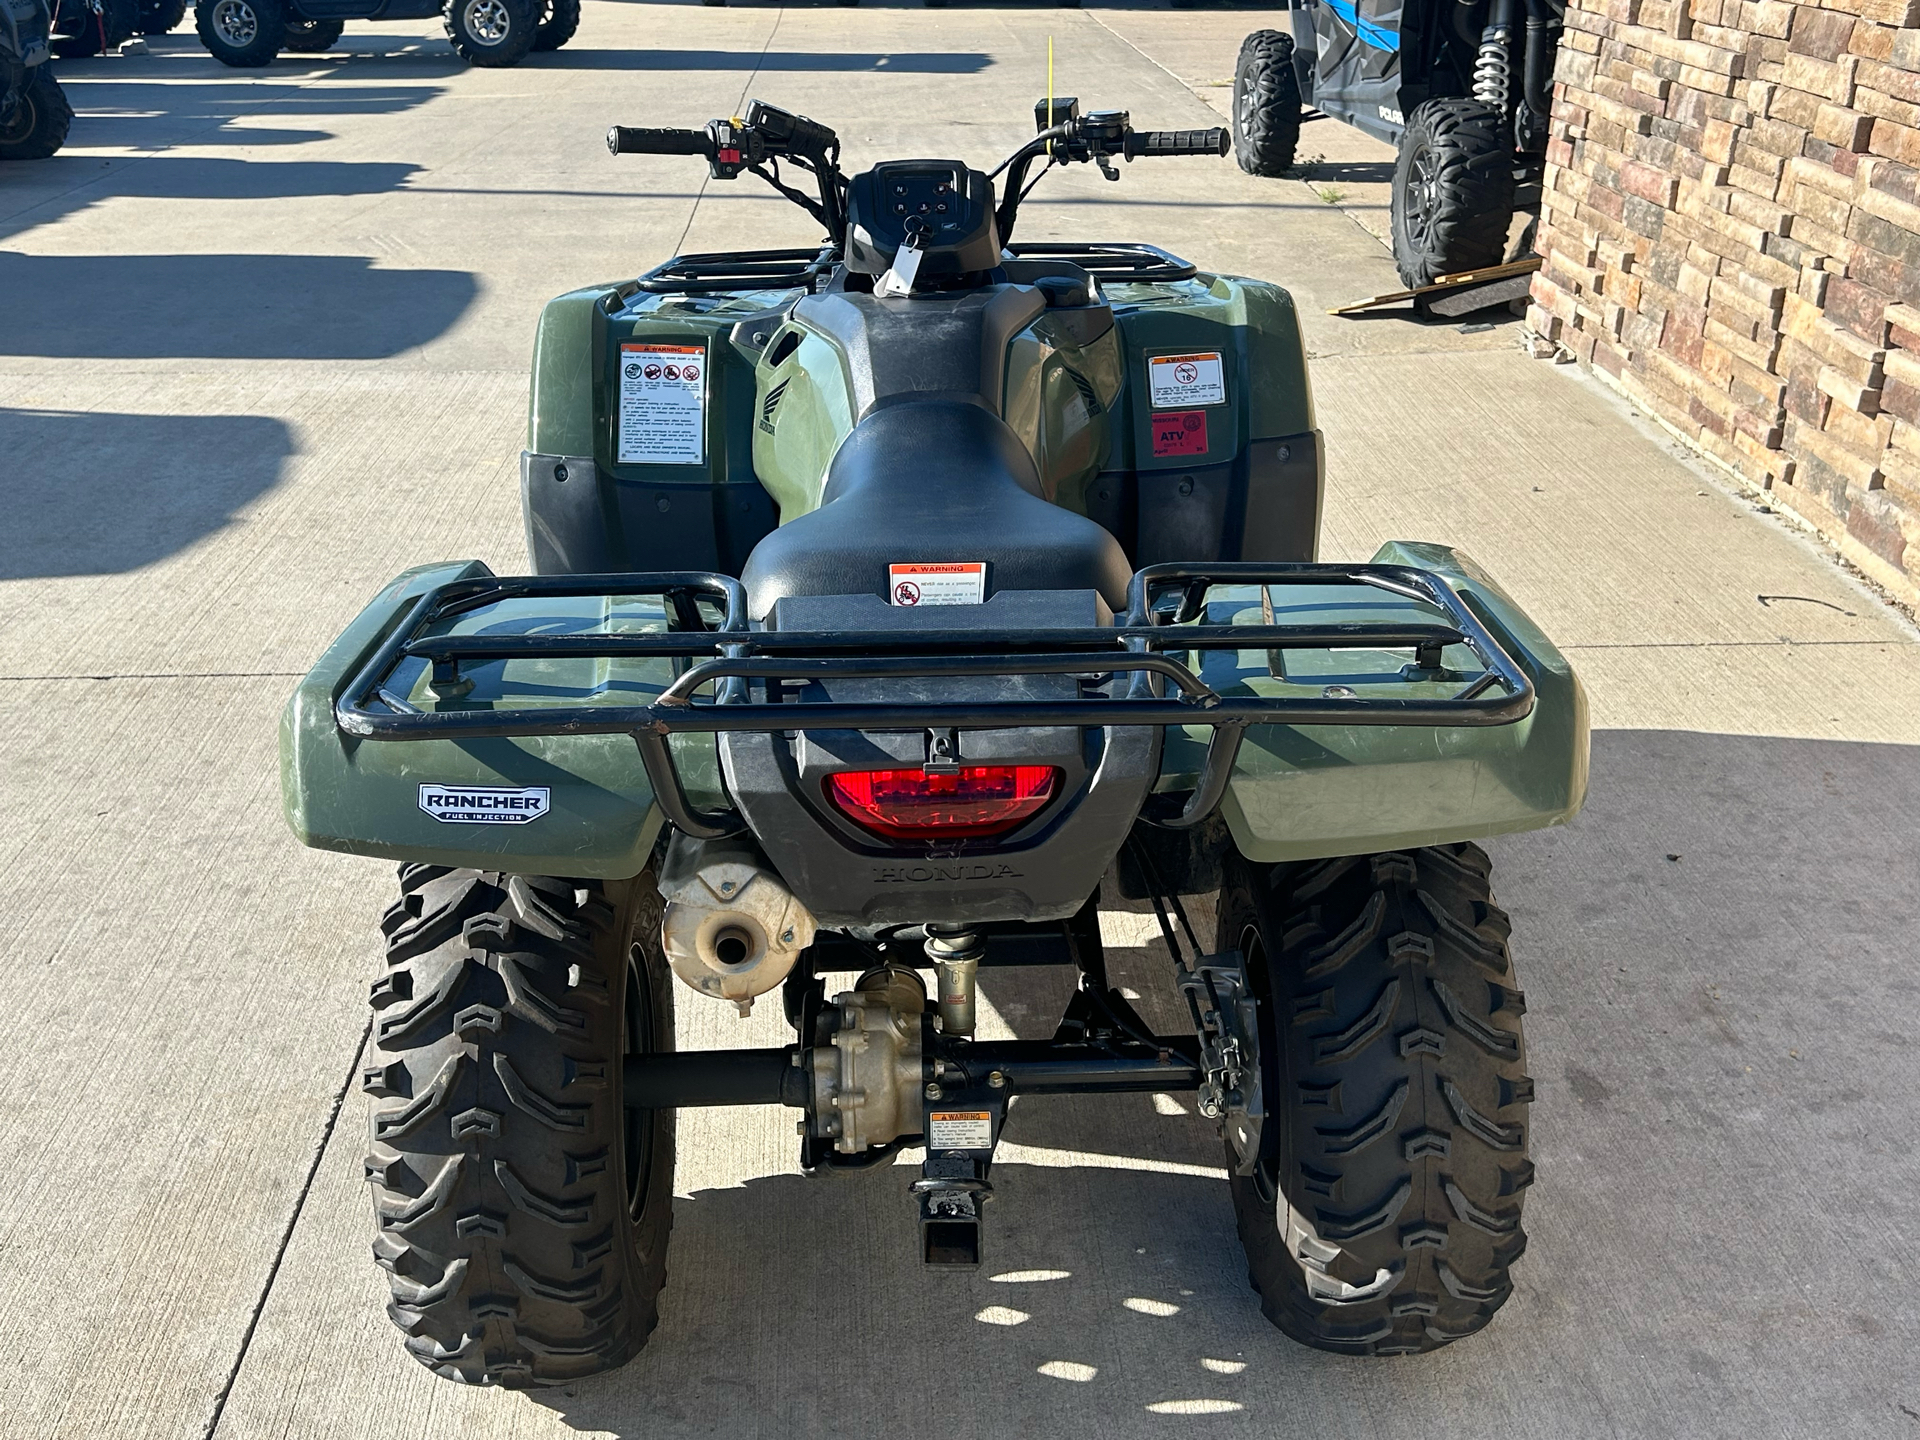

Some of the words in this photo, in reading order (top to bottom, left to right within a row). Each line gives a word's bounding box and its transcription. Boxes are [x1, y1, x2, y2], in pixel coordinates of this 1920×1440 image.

[1379, 105, 1405, 126] POLAR
[1161, 431, 1184, 441] ATV
[427, 794, 541, 810] RANCHER
[873, 864, 1024, 882] HONDA
